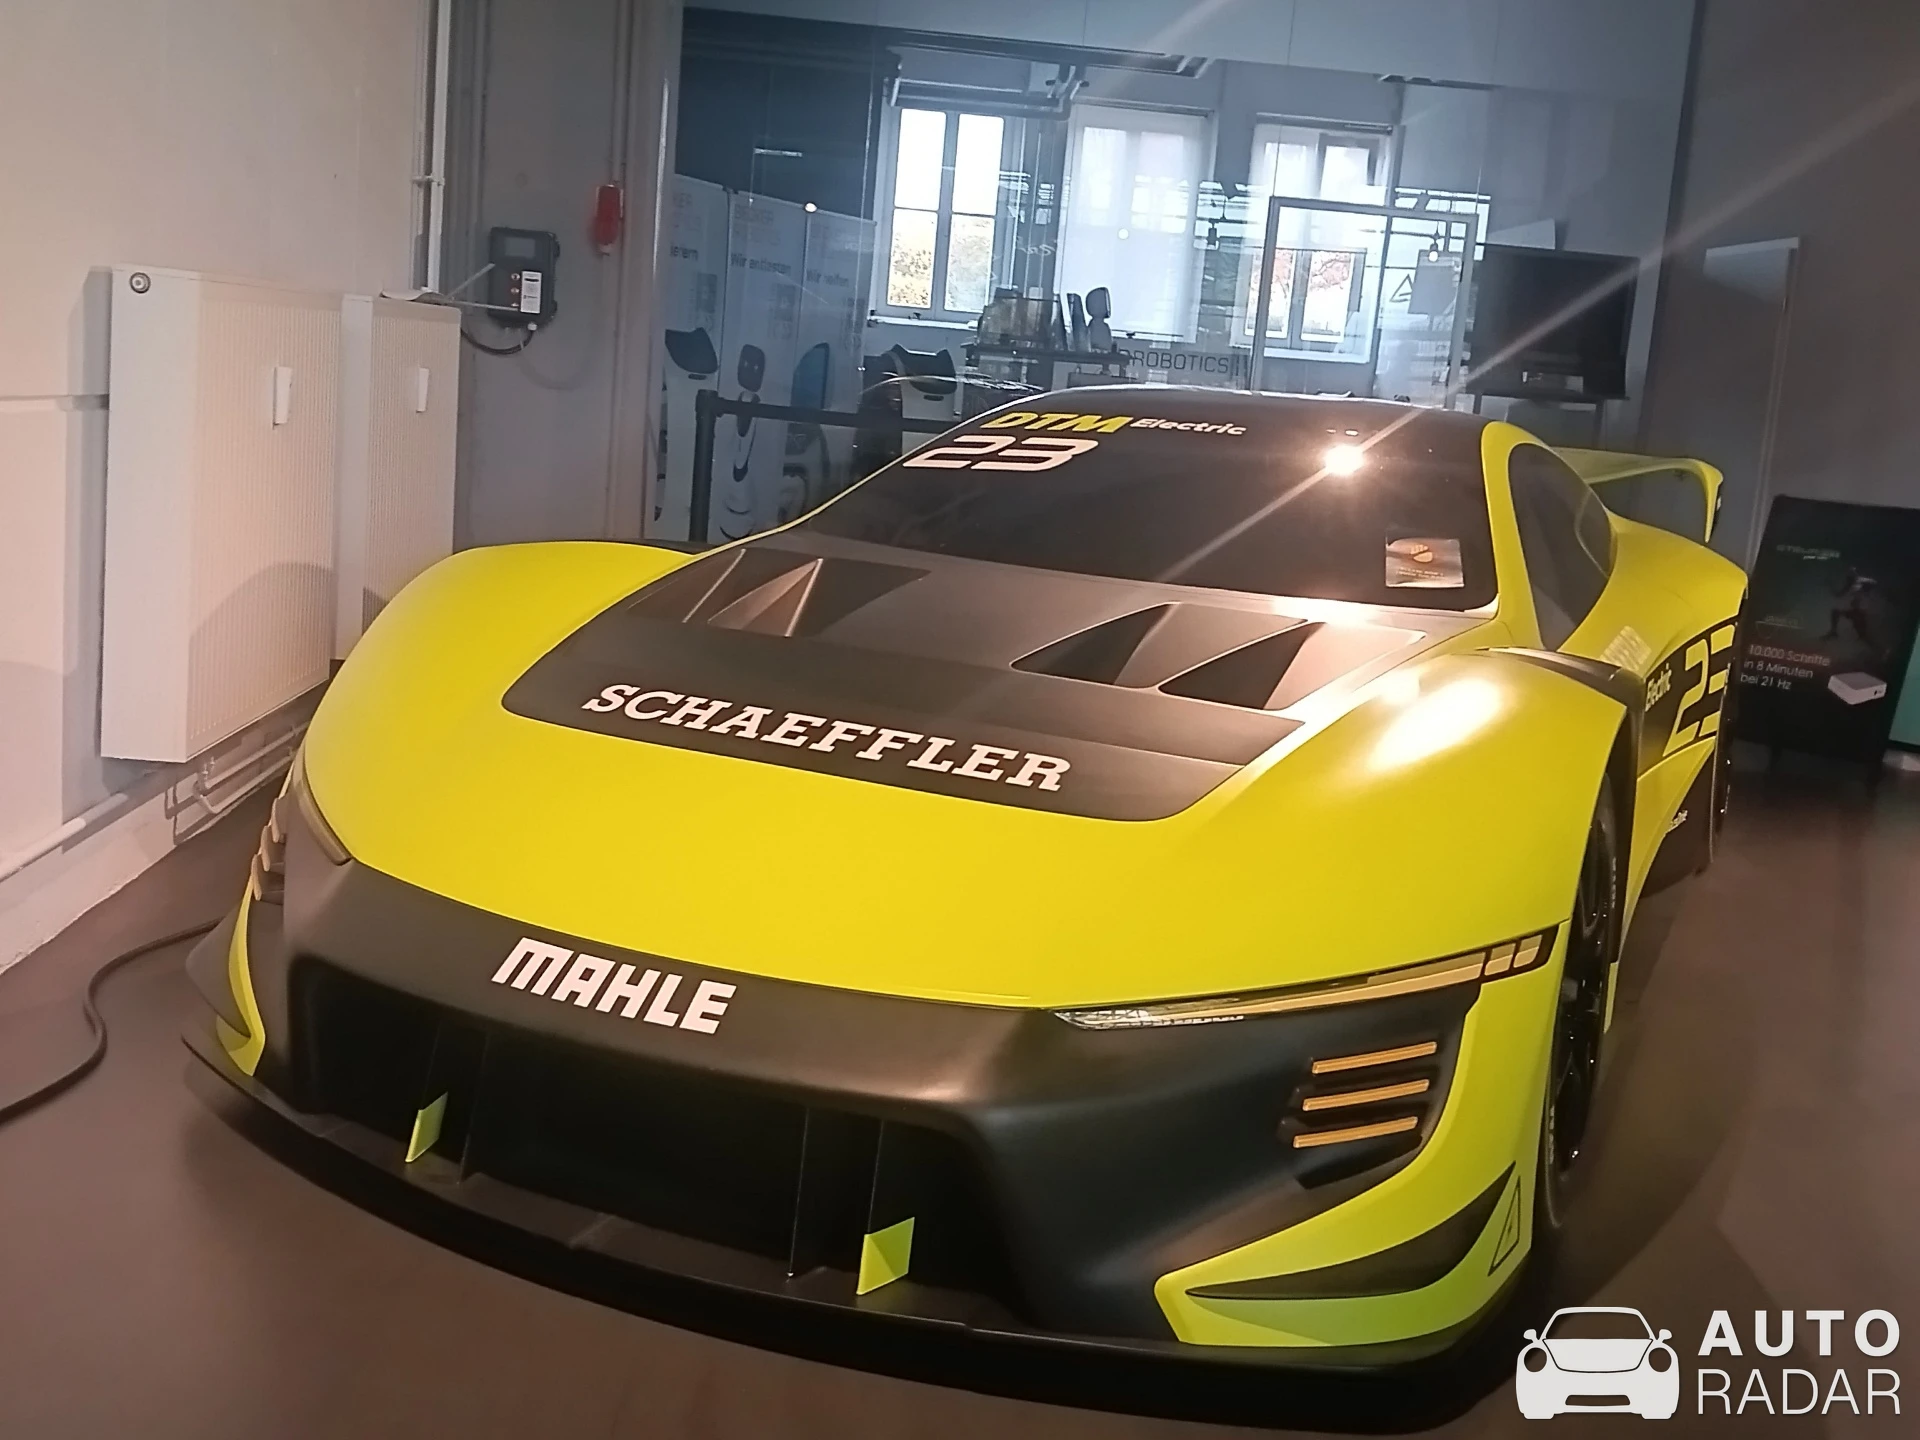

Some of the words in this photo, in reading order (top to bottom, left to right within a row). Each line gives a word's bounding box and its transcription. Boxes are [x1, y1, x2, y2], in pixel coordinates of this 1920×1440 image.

[980, 412, 1134, 432] DTM
[1130, 418, 1247, 436] Electric
[903, 435, 1099, 471] 23
[1749, 644, 1785, 660] 10.000
[1787, 651, 1830, 666] Schritte
[1744, 659, 1754, 669] in
[1756, 660, 1764, 671] 8
[1766, 664, 1814, 678] Minuten
[1740, 672, 1758, 685] bei
[1761, 675, 1774, 687] 21
[1777, 678, 1792, 690] Hz
[581, 684, 1072, 792] SCHAEFFLER
[491, 937, 737, 1034] MAHLE
